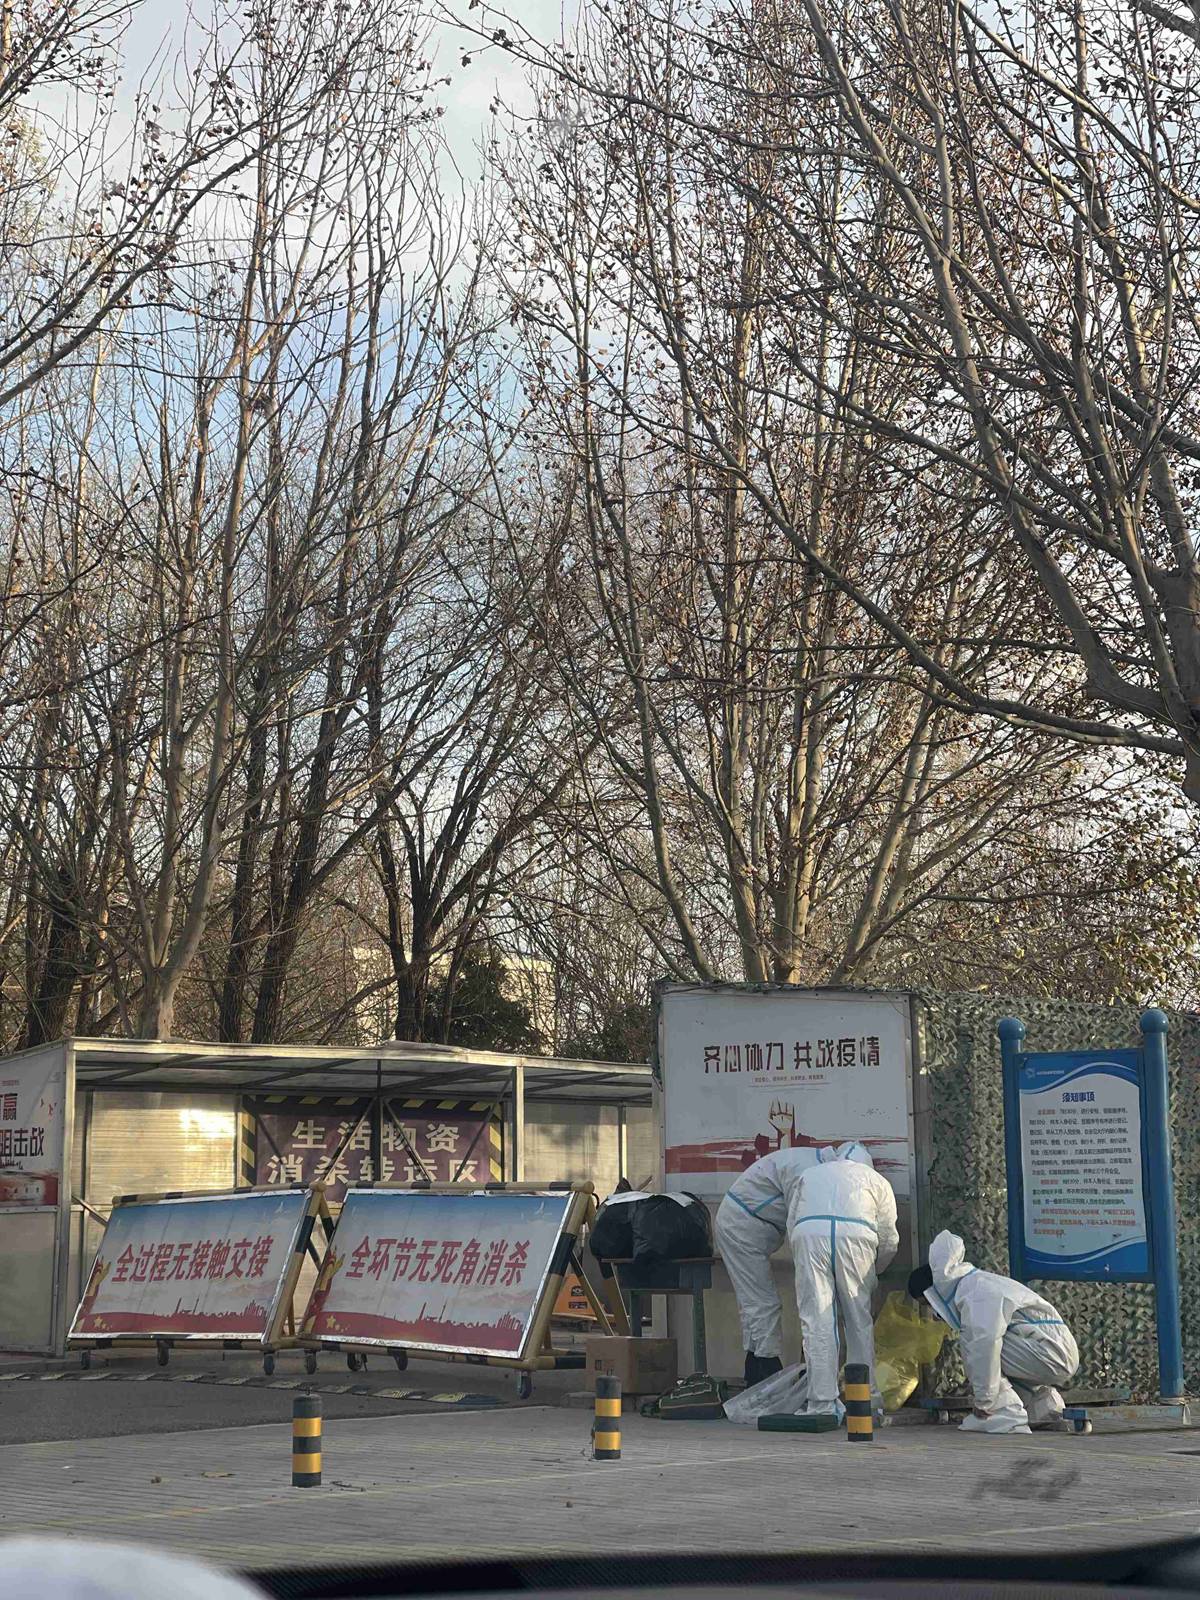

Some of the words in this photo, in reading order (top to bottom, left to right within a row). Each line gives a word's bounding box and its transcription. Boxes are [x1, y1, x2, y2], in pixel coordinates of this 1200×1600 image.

[703, 1041, 784, 1074] 齐心协力
[793, 1036, 880, 1070] 共战疫情
[1061, 1091, 1095, 1103] 须知事项
[291, 1119, 460, 1153] 生活物资
[112, 1235, 274, 1284] 全过程无接触交接
[345, 1234, 531, 1287] 全环节无死角消杀
